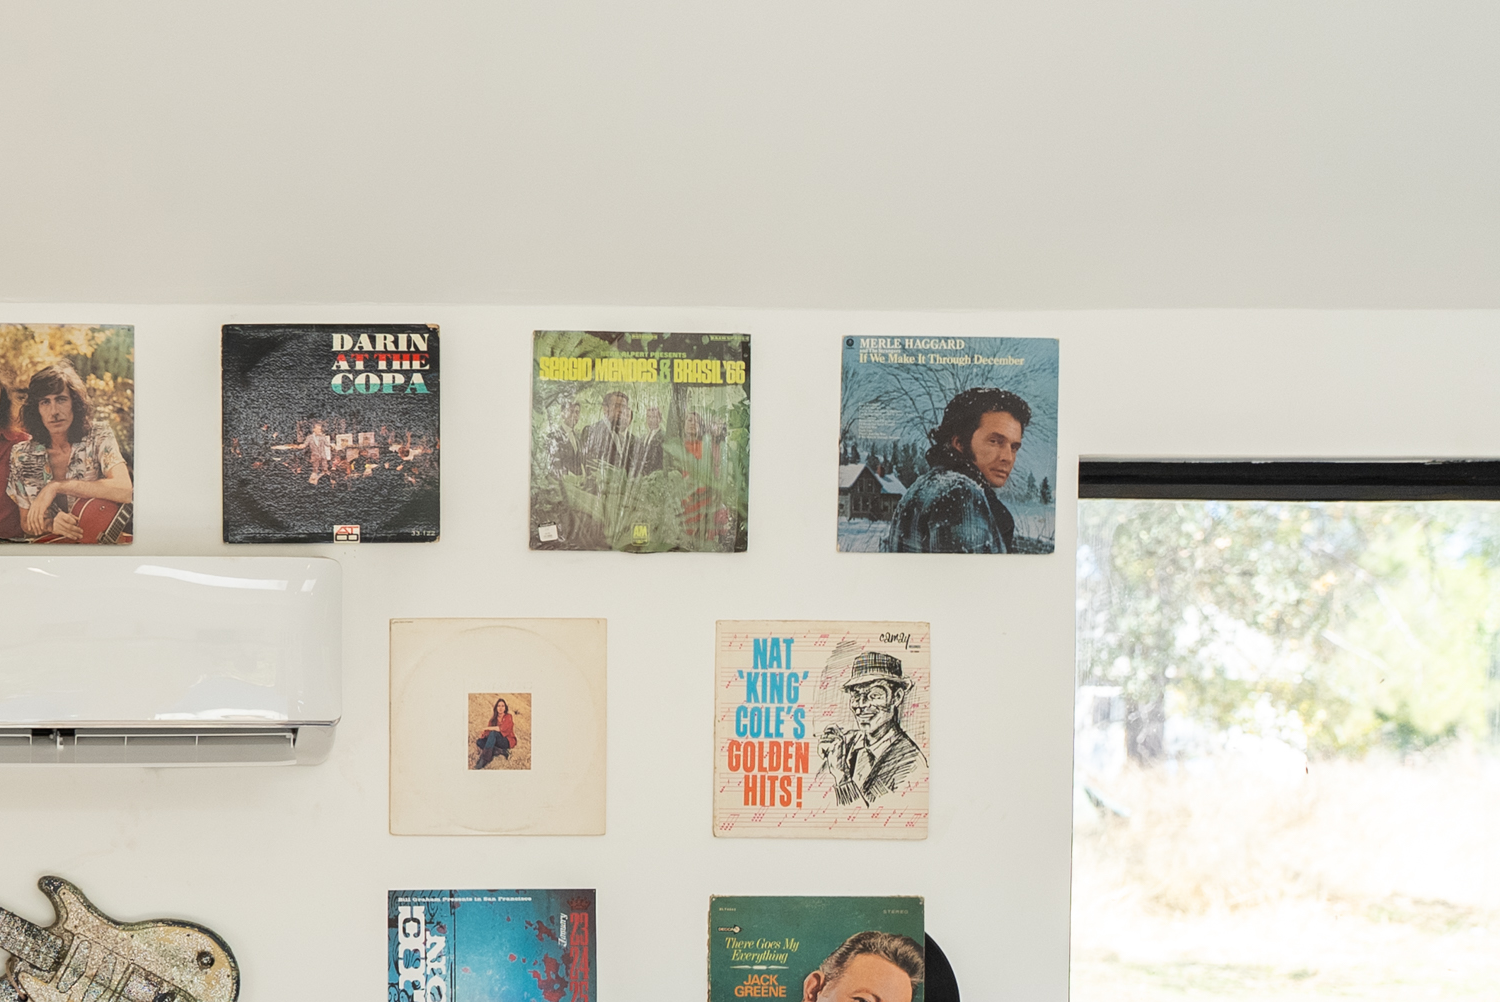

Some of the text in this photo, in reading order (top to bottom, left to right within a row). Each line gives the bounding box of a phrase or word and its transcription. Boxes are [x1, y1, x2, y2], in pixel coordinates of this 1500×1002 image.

[331, 333, 430, 351] DARIN
[860, 338, 965, 350] MERLE HAGGARD
[331, 353, 430, 370] AT THE
[859, 353, 1025, 366] If We Make It Through December
[659, 359, 671, 383] &
[673, 359, 723, 384] BRASIL
[330, 372, 430, 394] COPA
[752, 637, 794, 670] NAT
[735, 705, 805, 740] COLE'S
[727, 740, 809, 774] GOLDEN
[743, 774, 803, 809] HITS!
[569, 912, 589, 946] 23
[725, 937, 800, 953] There Goes My
[569, 946, 589, 980] 24
[731, 949, 789, 964] Everything
[743, 974, 779, 986] JACK
[734, 985, 787, 998] GREENE
